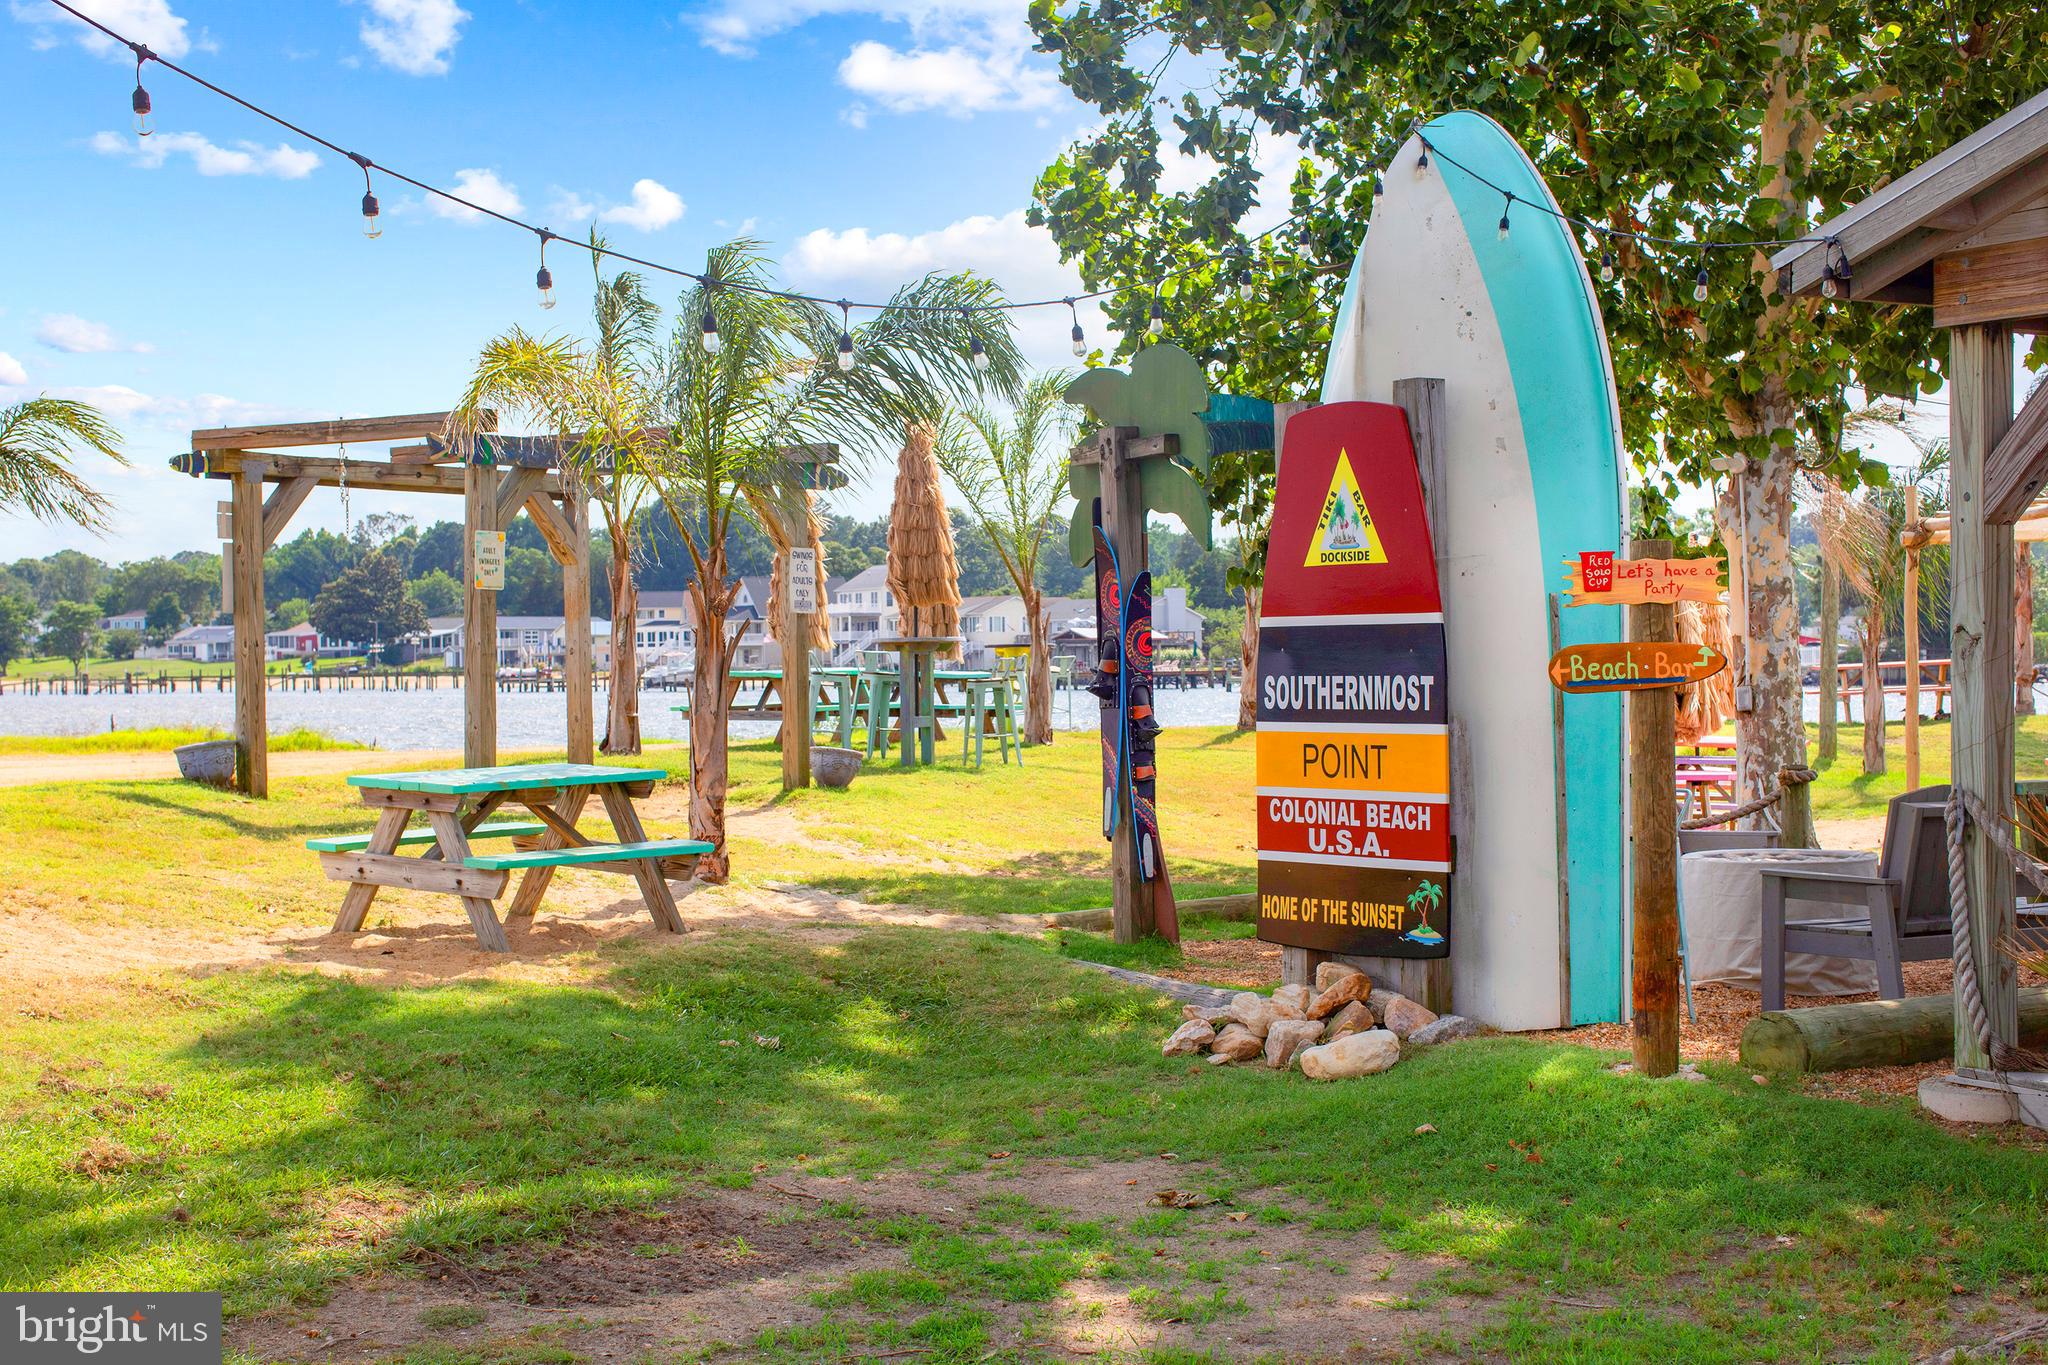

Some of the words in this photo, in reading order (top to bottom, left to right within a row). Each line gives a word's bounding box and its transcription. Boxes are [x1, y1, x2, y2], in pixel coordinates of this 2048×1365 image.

[1318, 491, 1338, 530] TIKI
[1352, 489, 1371, 528] BAR
[792, 550, 813, 560] SWINGS
[1321, 550, 1370, 563] DOCKSIDE
[1589, 554, 1610, 566] RED
[796, 563, 808, 573] FOR
[1586, 568, 1611, 578] SOLO
[1617, 562, 1654, 579] Let's
[1664, 562, 1697, 577] have
[1704, 568, 1716, 576] a
[792, 576, 813, 585] ADULTS
[1588, 577, 1609, 587] CUP
[1644, 579, 1685, 597] Party
[795, 588, 809, 598] ONLY
[1570, 650, 1639, 682] Beach
[1655, 651, 1697, 679] Bar
[1264, 674, 1434, 711] SOUTHERNMOST
[1303, 743, 1388, 779] POINT
[1269, 798, 1361, 827] COLONIAL
[1366, 803, 1431, 831] BEACH
[1308, 827, 1390, 857] U.S.A.
[1261, 894, 1298, 920] HOME
[1301, 897, 1319, 923] OF
[1321, 899, 1347, 925] THE
[1351, 901, 1405, 930] SUNSET
